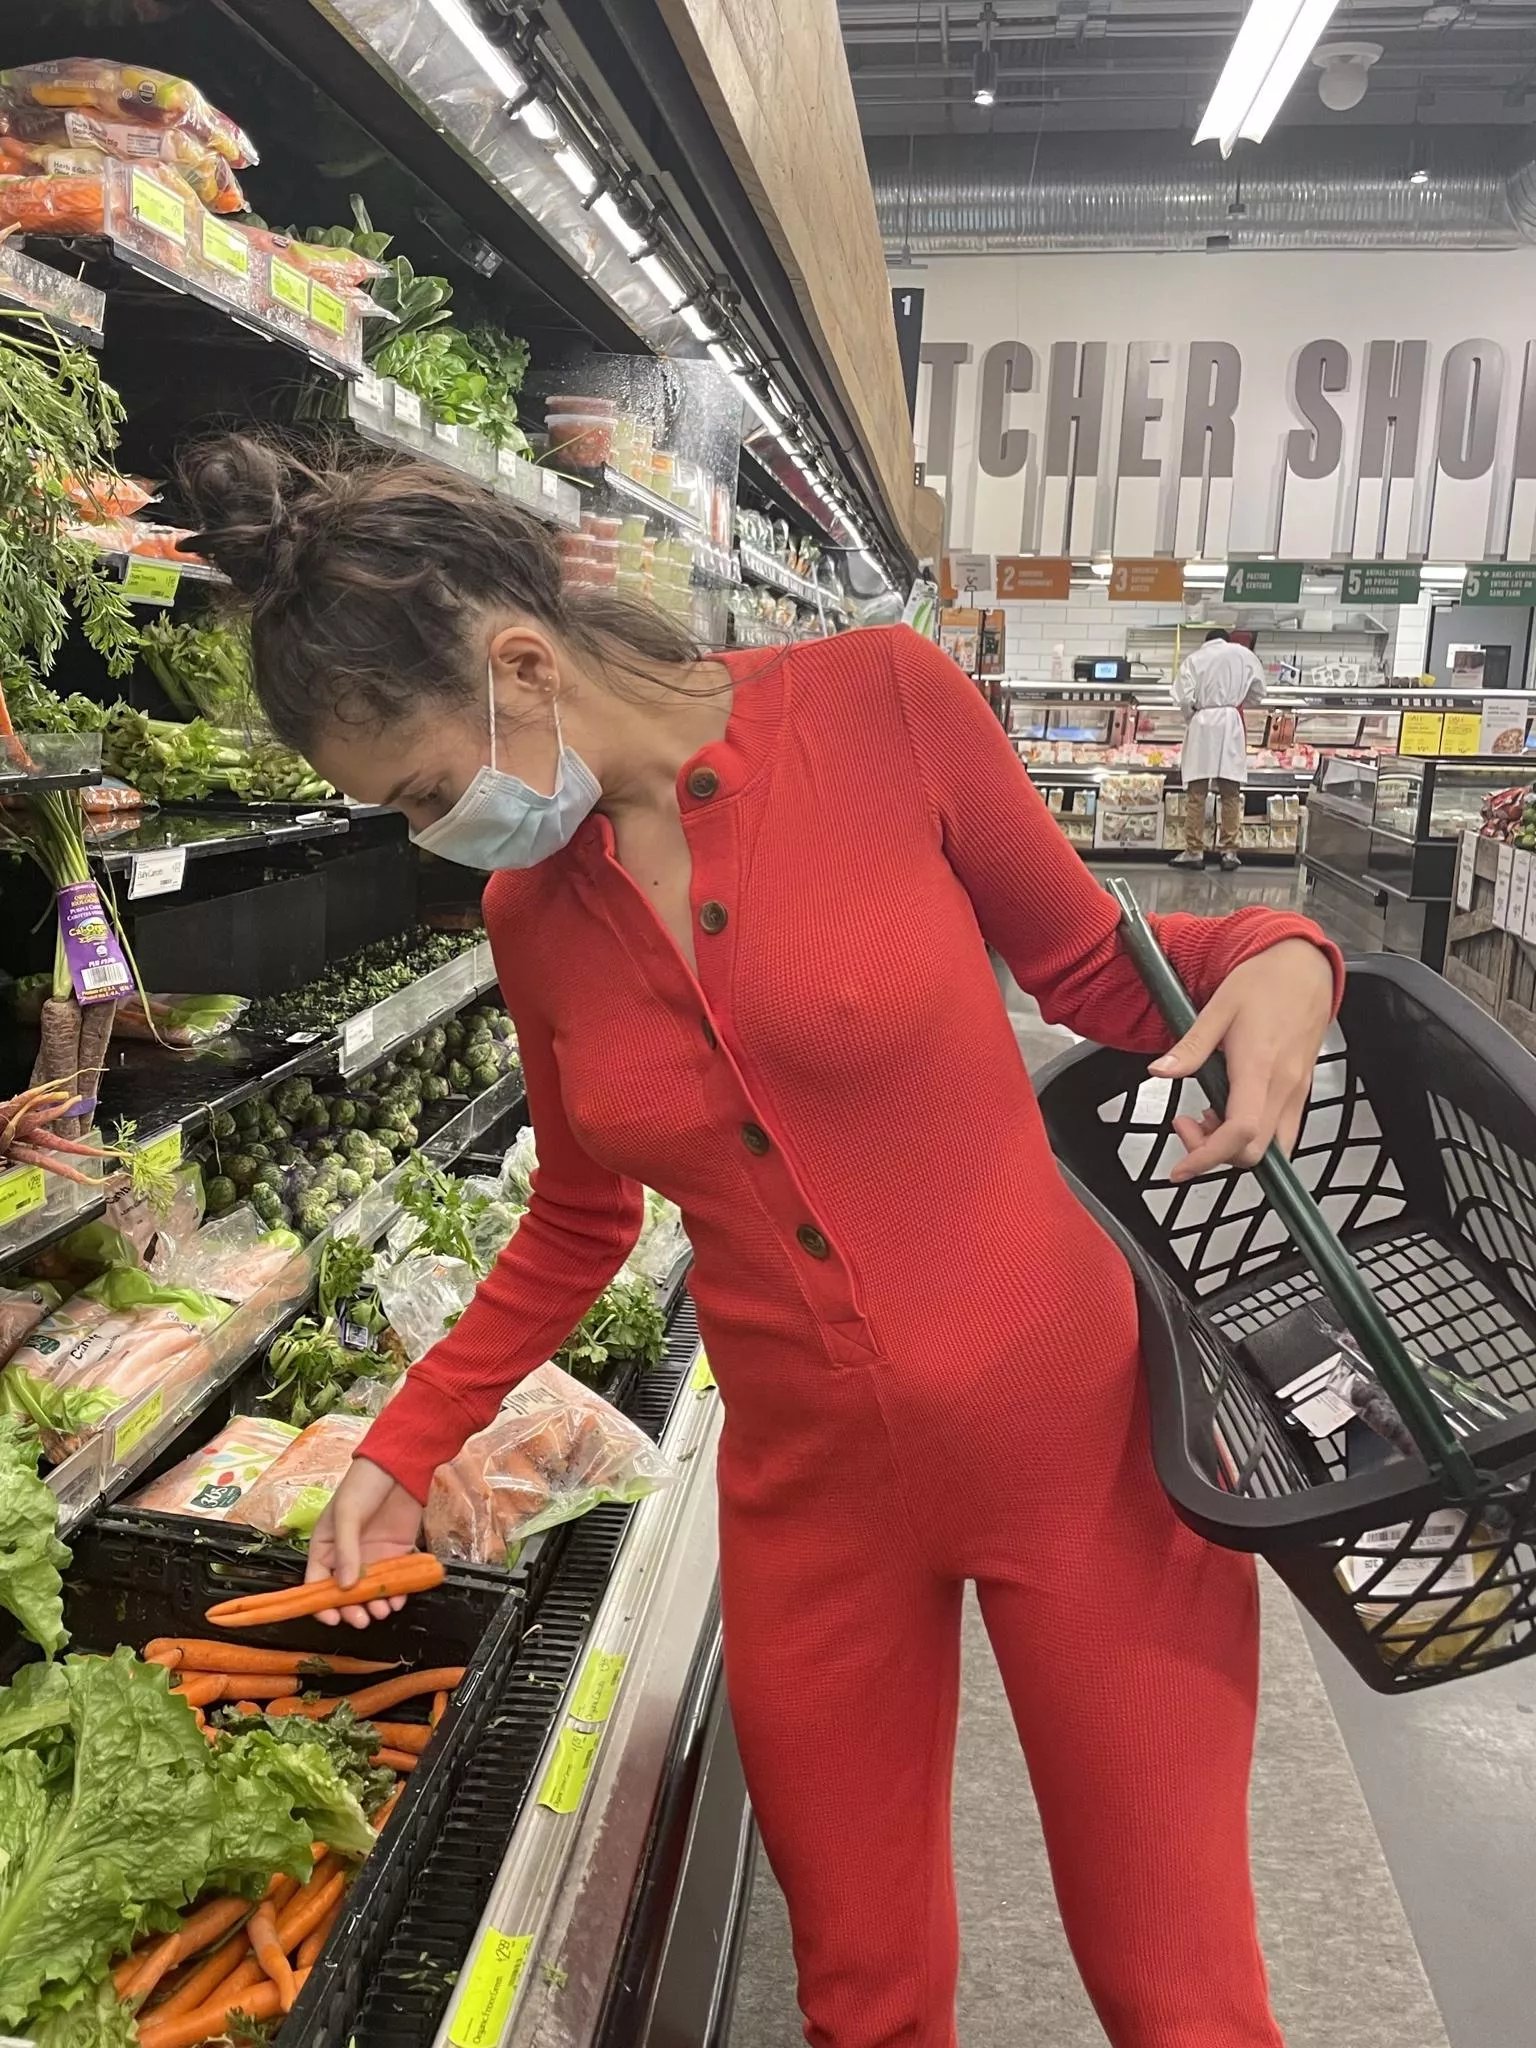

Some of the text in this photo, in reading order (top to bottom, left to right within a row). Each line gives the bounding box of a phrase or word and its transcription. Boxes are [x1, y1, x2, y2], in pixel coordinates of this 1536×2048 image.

[901, 295, 911, 315] 1
[1002, 566, 1016, 591] 2
[1115, 567, 1128, 592] 3
[1230, 568, 1244, 595] 4
[1348, 569, 1362, 596] 5
[200, 1486, 228, 1507] 365
